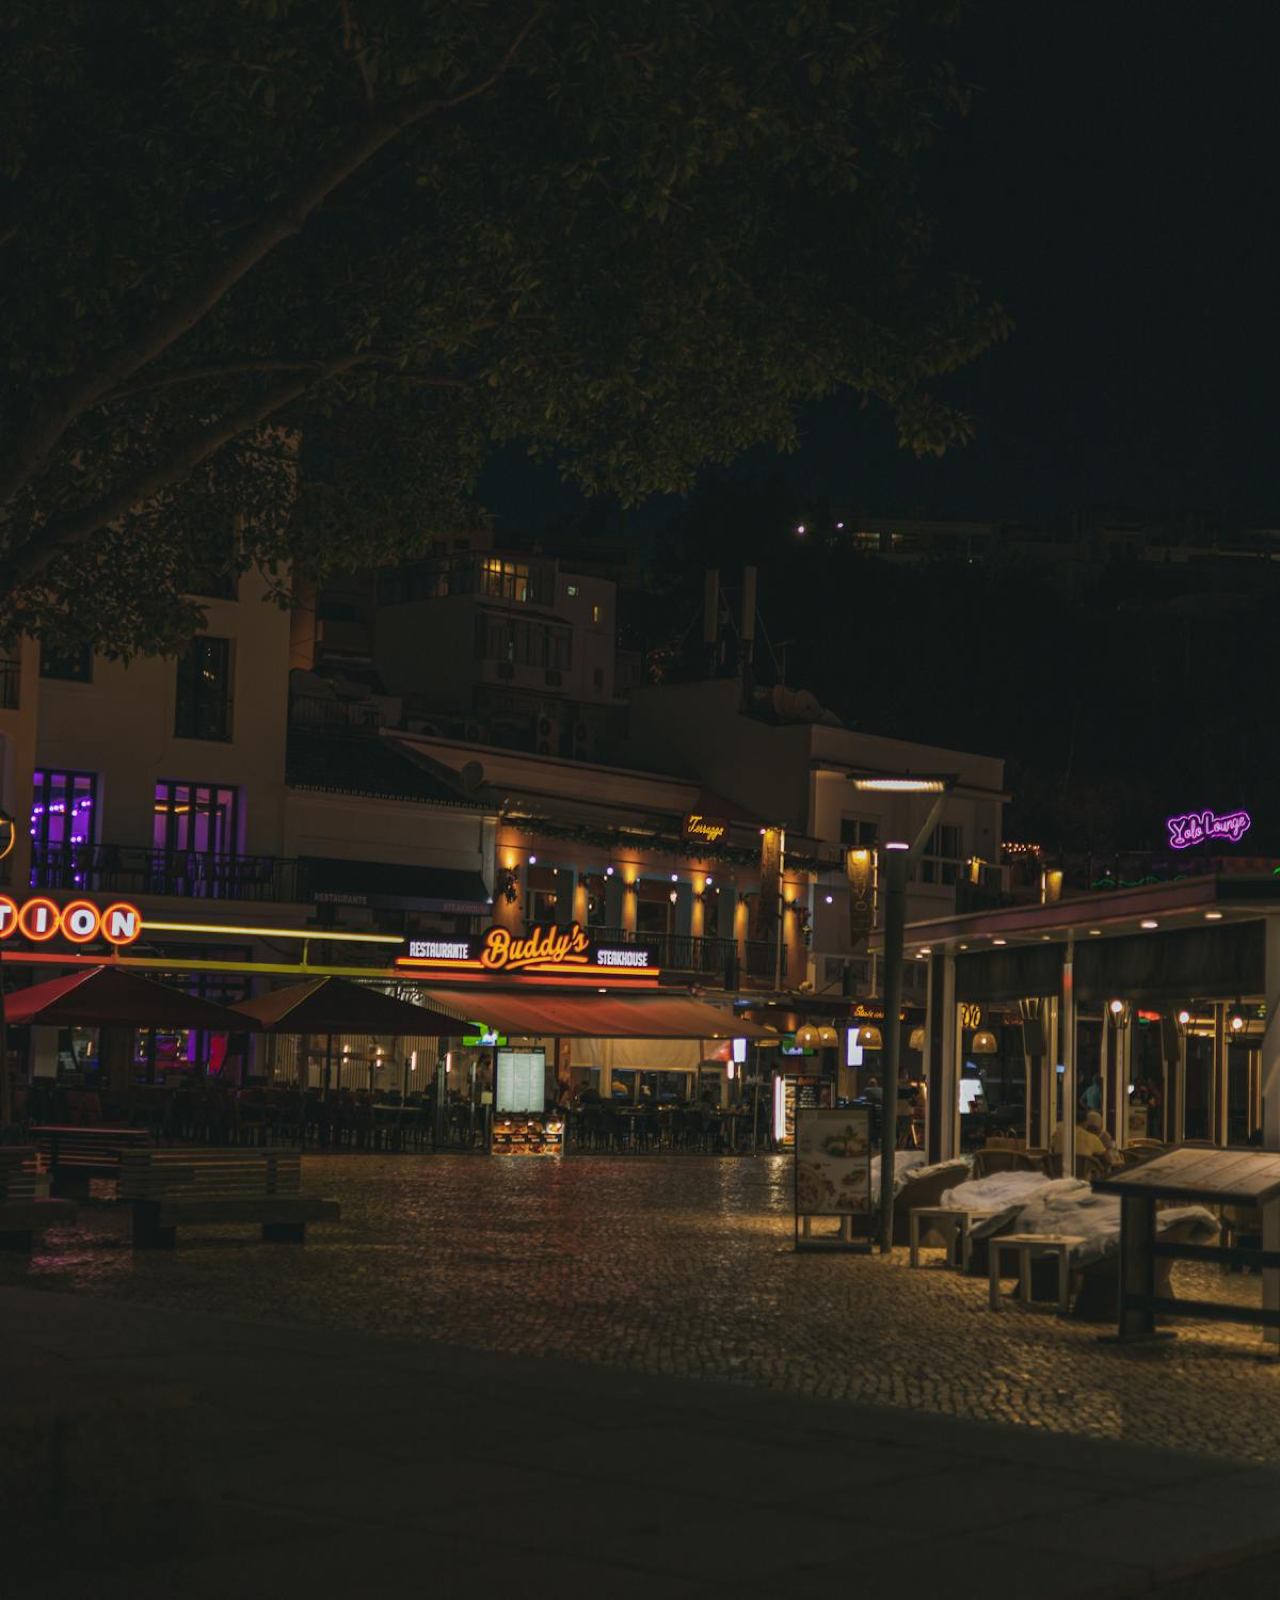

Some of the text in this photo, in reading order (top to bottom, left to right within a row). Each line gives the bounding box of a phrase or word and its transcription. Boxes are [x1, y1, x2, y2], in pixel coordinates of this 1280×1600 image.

[1172, 815, 1247, 844] Yolo Lounge
[409, 923, 649, 970] RESTAURANTE Buddy's STEAKHOUSE
